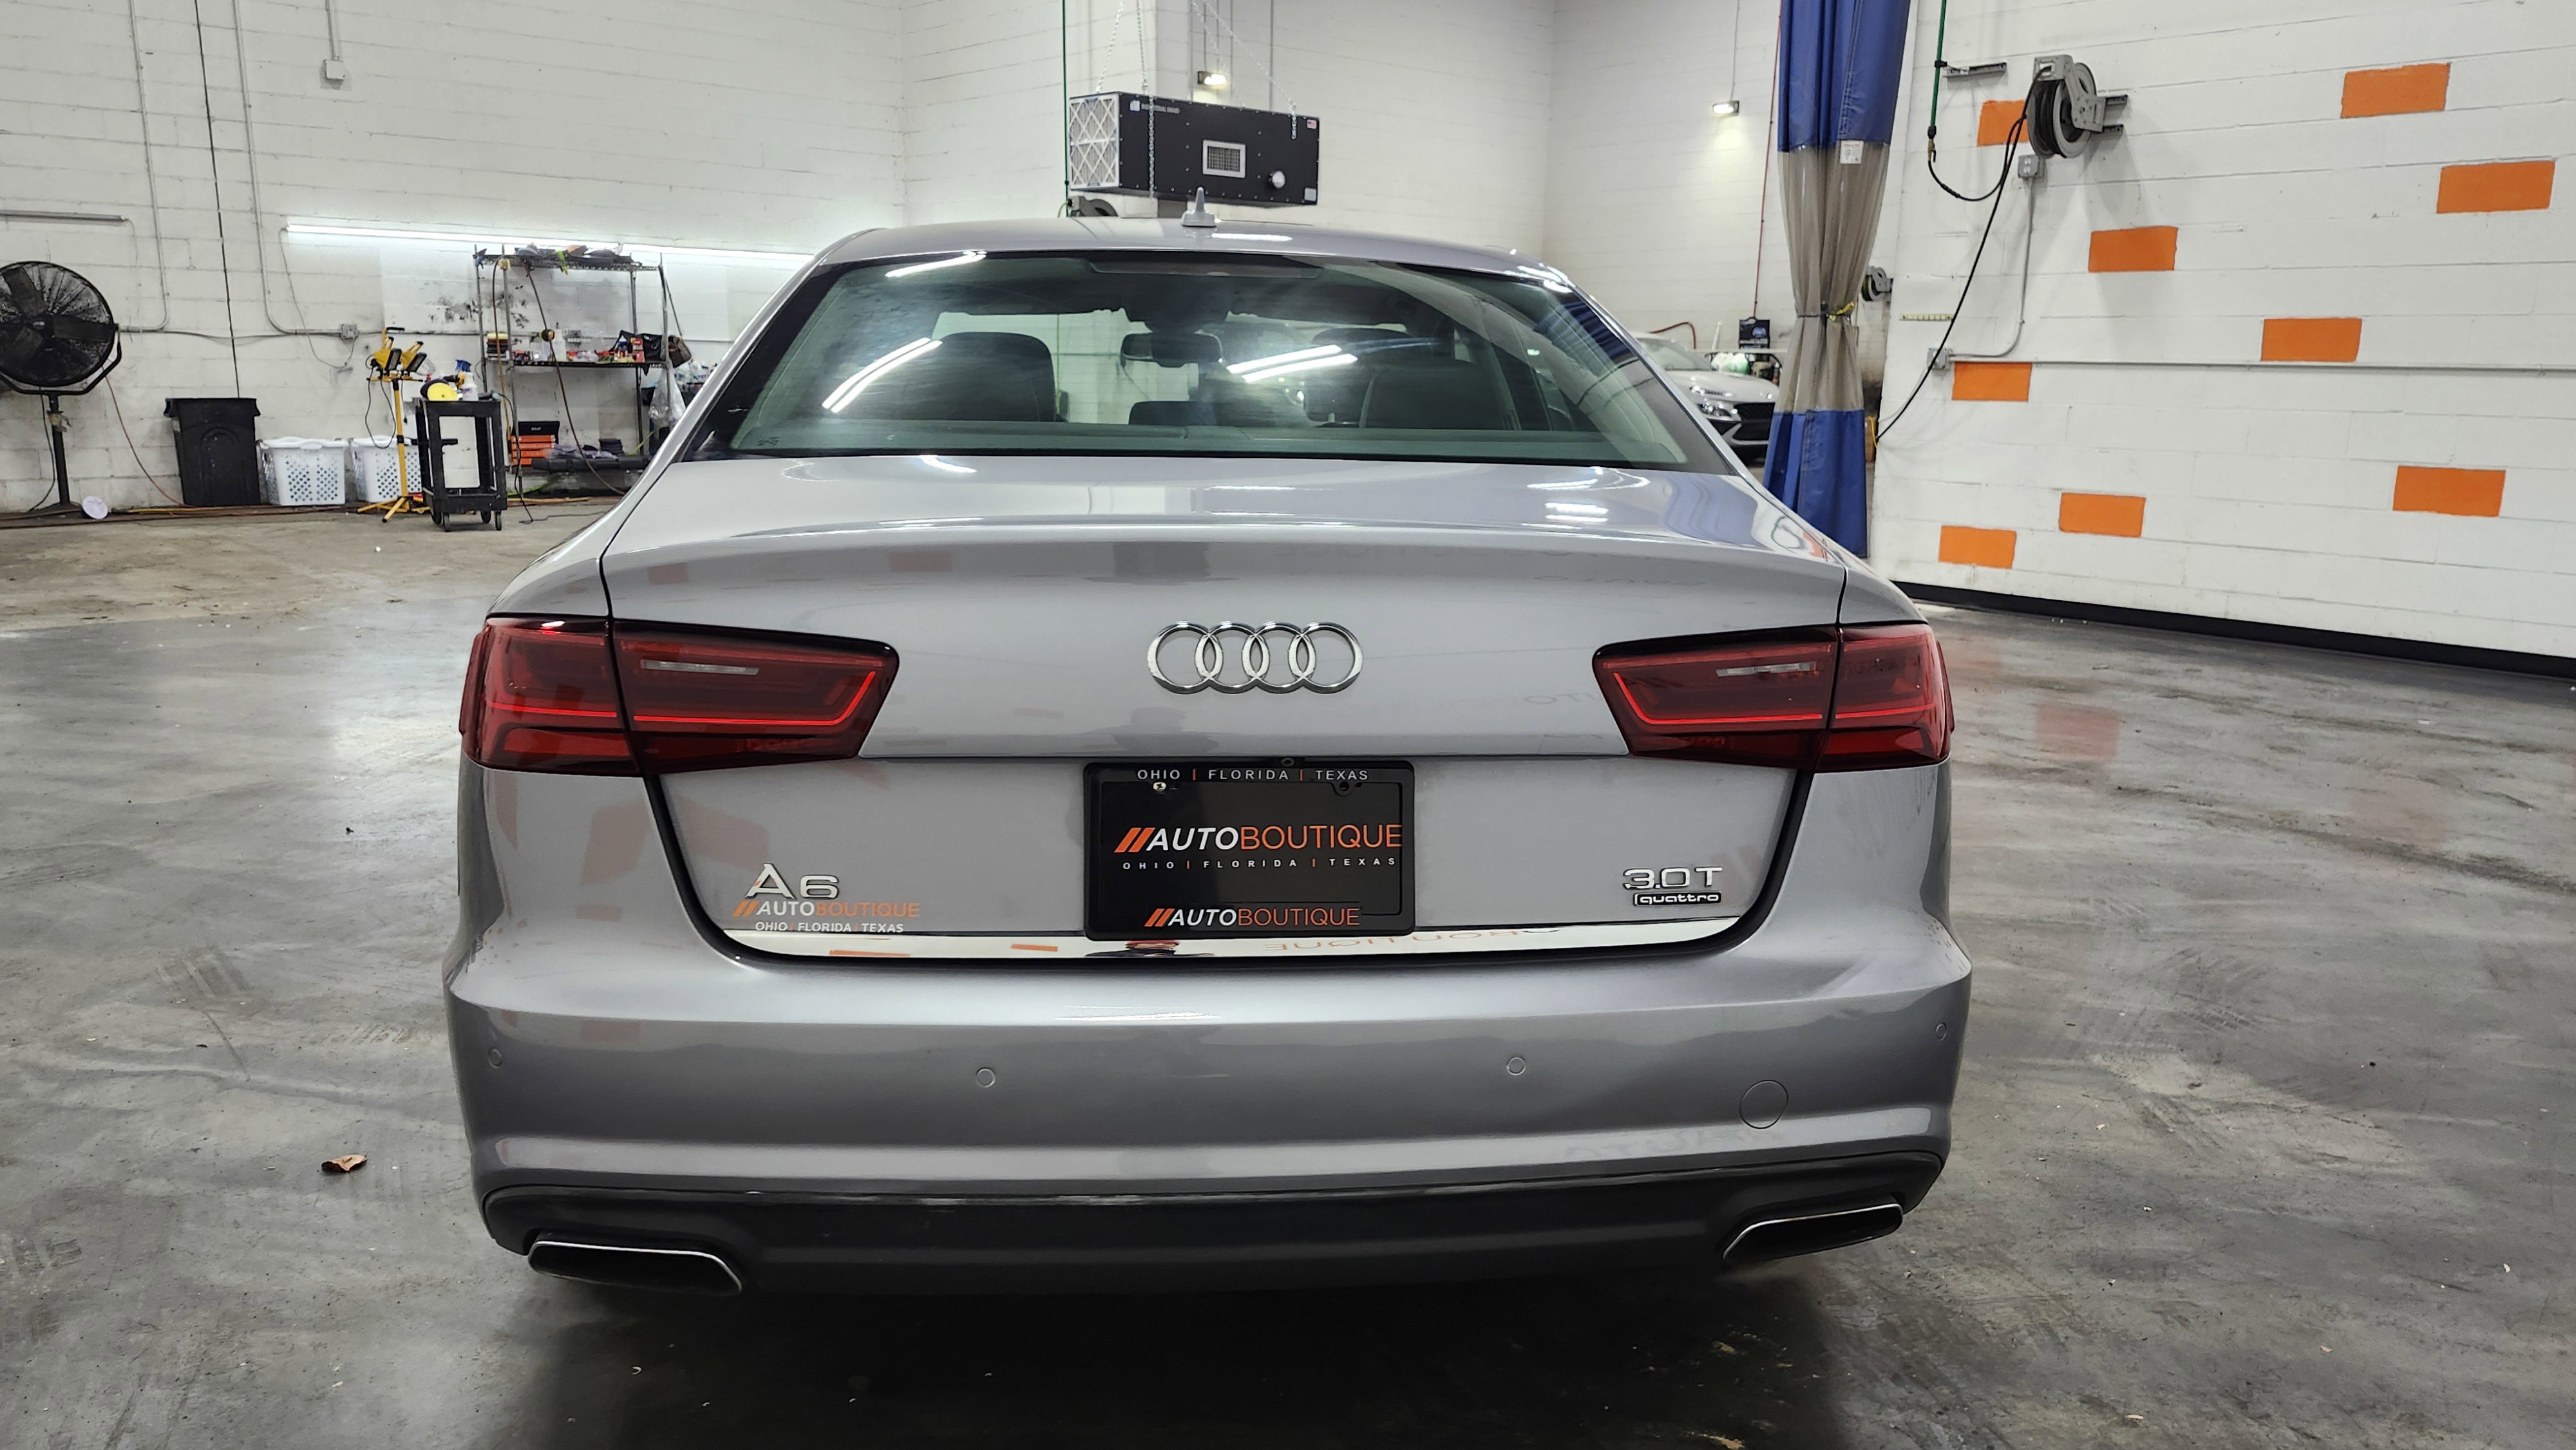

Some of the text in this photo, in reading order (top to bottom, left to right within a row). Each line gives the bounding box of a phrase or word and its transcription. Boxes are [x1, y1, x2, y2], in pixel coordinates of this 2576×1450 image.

[1137, 769, 1368, 780] OHIO FLORIDA TEXAS
[1146, 824, 1403, 851] AUTOBOUTIQUE
[1204, 860, 1297, 868] FLORIDA
[1330, 857, 1396, 865] TEXAS
[744, 862, 840, 899] A6
[1623, 867, 1723, 889] 3.0T
[1640, 894, 1719, 905] quattro
[756, 901, 920, 917] AUTOBOUTIQUE
[1168, 907, 1359, 926] AUTOBOUTIQUE
[755, 921, 904, 933] OHIO FLORIDA TEXAS
